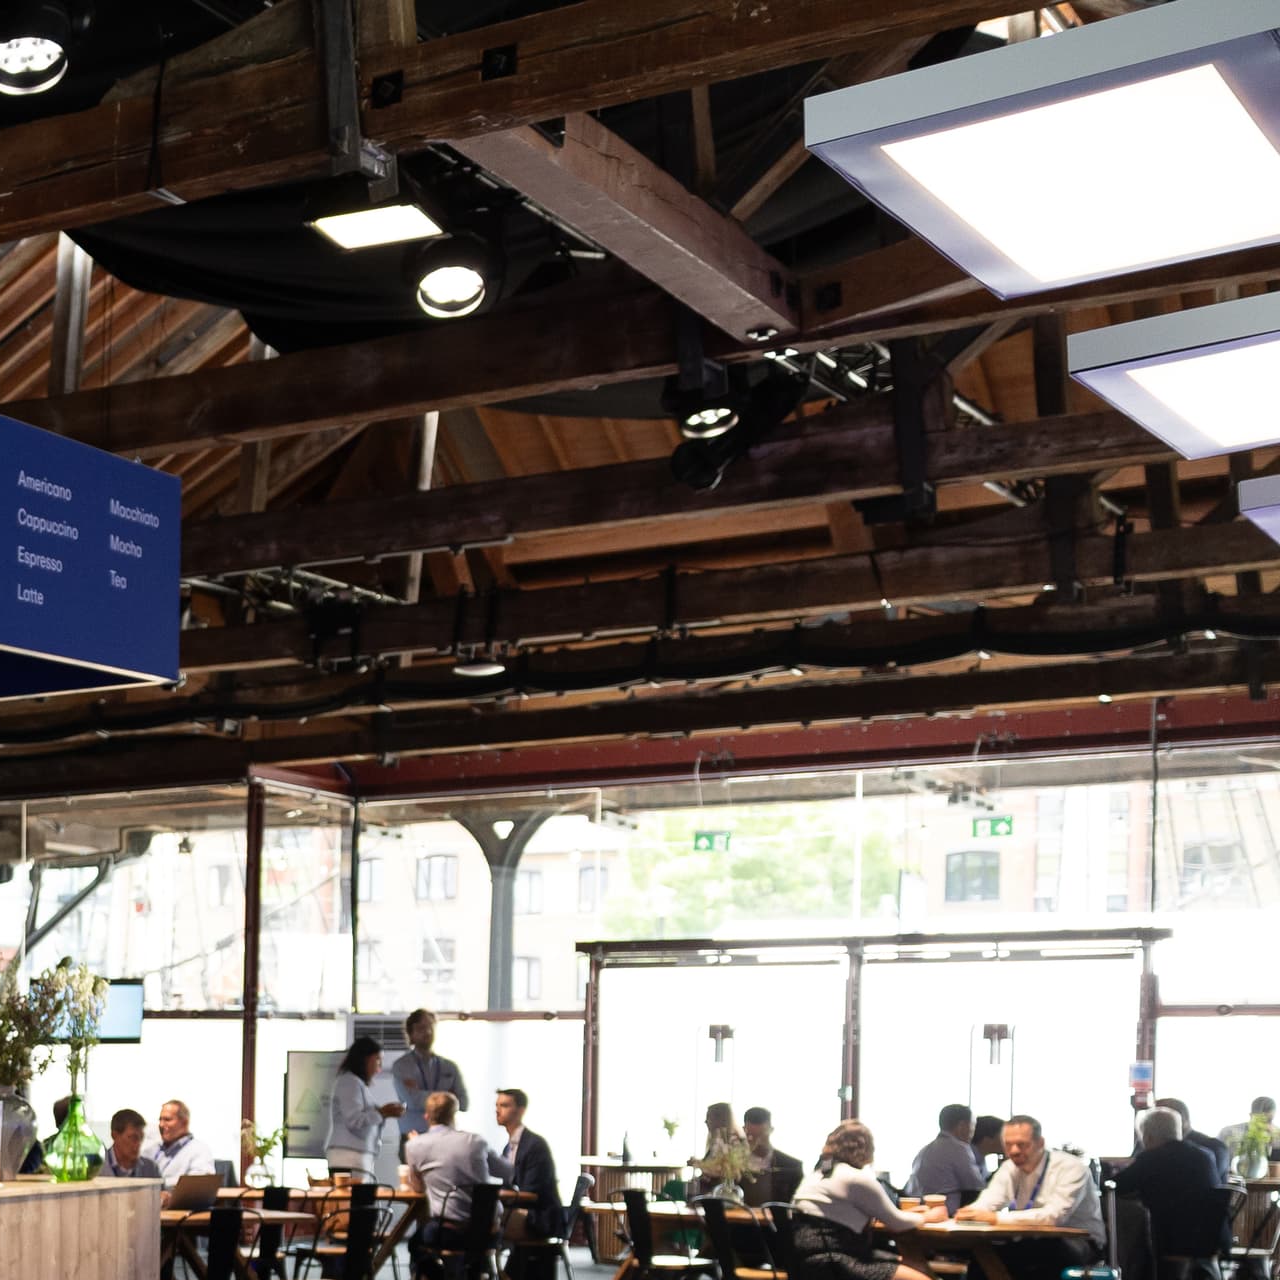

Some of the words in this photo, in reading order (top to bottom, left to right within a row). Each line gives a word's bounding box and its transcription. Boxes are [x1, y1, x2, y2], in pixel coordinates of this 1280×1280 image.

[17, 470, 73, 502] Americano
[17, 508, 79, 540] Cappuccino
[109, 498, 160, 529] Macchiato
[17, 545, 63, 573] Espresso
[109, 534, 143, 558] Mocha
[109, 569, 127, 590] Tea
[17, 583, 44, 606] Latte
